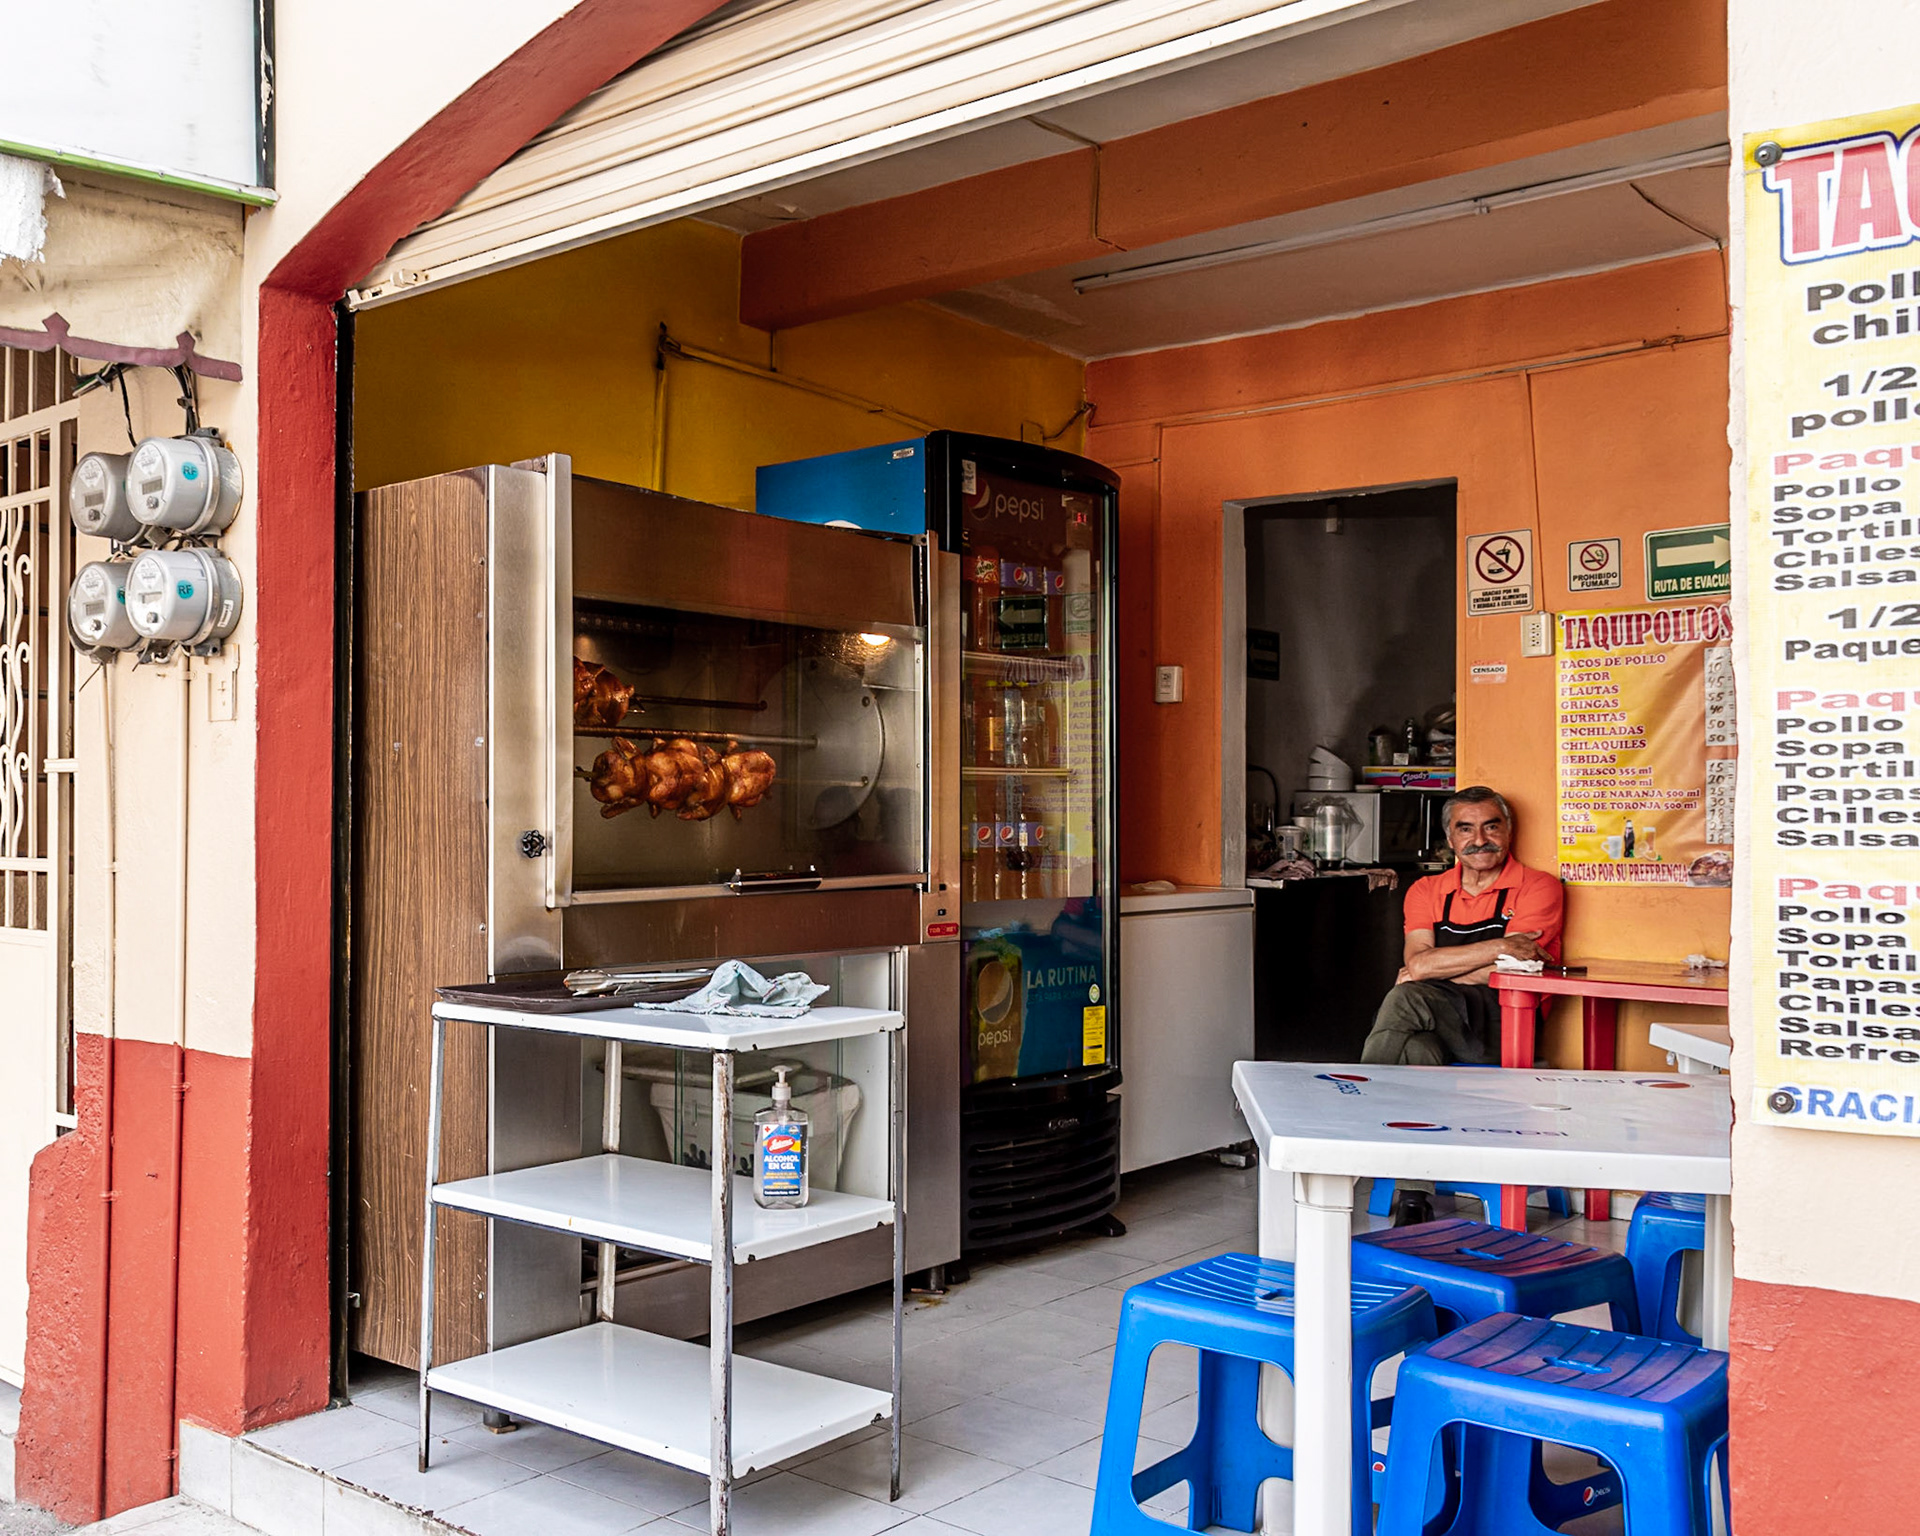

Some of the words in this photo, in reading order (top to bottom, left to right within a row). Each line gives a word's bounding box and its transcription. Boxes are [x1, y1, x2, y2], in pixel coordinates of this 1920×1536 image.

[1775, 136, 1920, 254] TA
[1813, 306, 1920, 345] chi
[1824, 366, 1917, 397] 1/2
[1792, 397, 1920, 438] poll
[184, 465, 197, 475] RF
[1774, 445, 1920, 476] Paq
[1774, 477, 1901, 502] Pollo
[995, 494, 1044, 523] pepsi
[1773, 501, 1902, 524] Sopa
[1772, 518, 1920, 546] Tortil
[1572, 571, 1617, 581] PROHIBIDO
[1581, 579, 1609, 588] FUMAR
[1654, 578, 1678, 593] RUTA
[1680, 577, 1692, 590] DE
[1774, 569, 1917, 591] Salsa
[178, 584, 192, 594] RF
[1828, 603, 1920, 629] 1/2
[1562, 605, 1732, 650] TAQUIPOLLOS
[1785, 638, 1920, 662] Paque
[1560, 658, 1601, 669] TACOS
[1604, 657, 1621, 666] DE
[1625, 654, 1666, 665] POLLO
[1560, 671, 1610, 682] PASTOR
[1560, 685, 1619, 696] FLAUTAS
[1560, 698, 1619, 709] GRINGAS
[1777, 690, 1920, 712] Paq
[1560, 712, 1626, 724] BURRITAS
[1777, 715, 1903, 734] Pollo
[1561, 726, 1644, 737] ENCHILADAS
[1561, 739, 1647, 751] CHILAQUILES
[1776, 740, 1904, 759] Sopa
[1561, 754, 1617, 764] BEBIDAS
[1561, 767, 1616, 776] REFRESCO
[1775, 760, 1920, 779] Tortil
[1561, 779, 1616, 787] REFRESCO
[1618, 779, 1636, 787] 600
[1639, 778, 1652, 786] ml
[1561, 791, 1590, 799] JUGO
[1609, 790, 1663, 798] NARANJA
[1561, 802, 1591, 811] JUGO
[1593, 802, 1607, 810] DE
[1611, 801, 1661, 810] TORONJA
[1664, 802, 1682, 810] 500
[1561, 812, 1590, 821] CAFÉ
[1561, 825, 1596, 833] LECHE
[1776, 829, 1919, 847] Salsa
[1561, 835, 1575, 844] TÉ
[1560, 863, 1596, 881] GRACIAS
[1598, 863, 1614, 882] POR
[1616, 864, 1627, 882] SU
[1628, 863, 1688, 883] PREFERENCIA
[1779, 878, 1920, 906] Paq
[1778, 905, 1906, 924] Pollo
[1778, 927, 1906, 950] Sopa
[1777, 949, 1917, 972] Tortil
[1027, 969, 1044, 989] LA
[1047, 965, 1097, 987] RUTINA
[1778, 994, 1920, 1018] Chile
[978, 1025, 1012, 1051] pepsi
[1779, 1017, 1920, 1041] Salsa
[1780, 1039, 1920, 1063] Refre
[1778, 1086, 1920, 1124] GRACI
[1461, 1127, 1569, 1136] pepsi
[768, 1162, 780, 1170] EN
[780, 1162, 795, 1170] GEL
